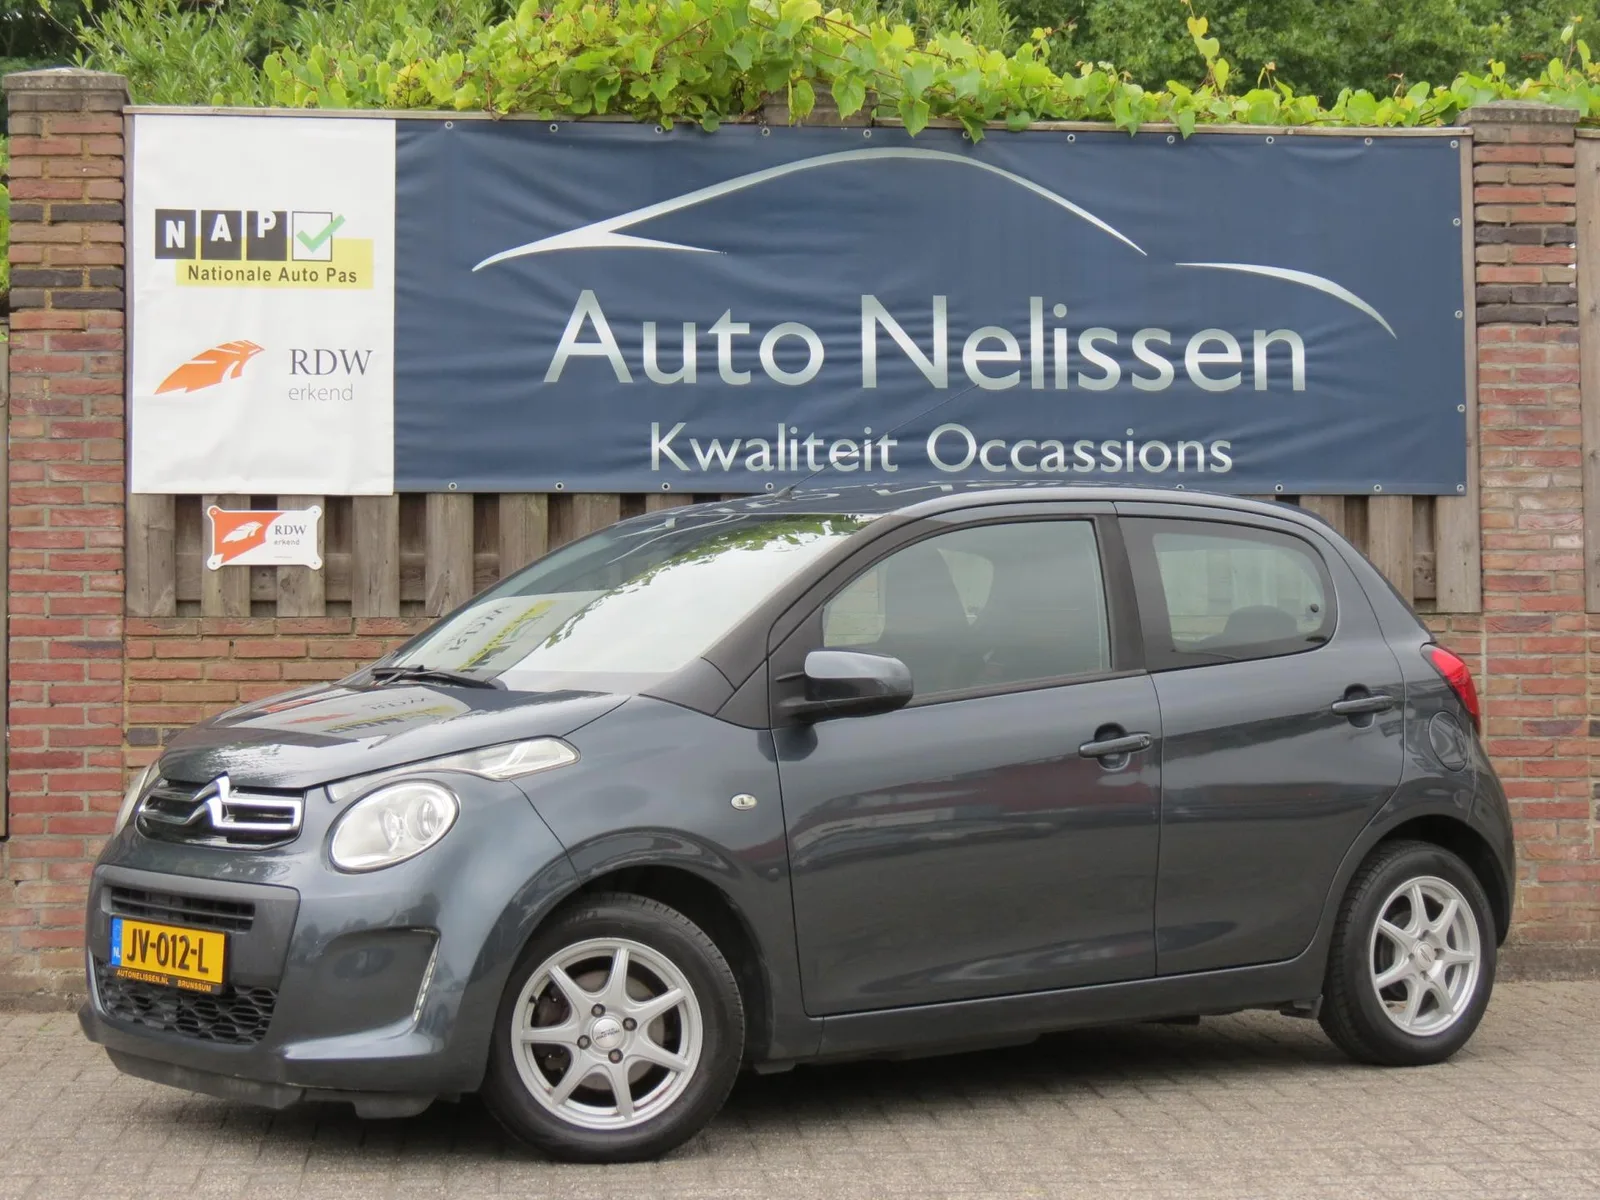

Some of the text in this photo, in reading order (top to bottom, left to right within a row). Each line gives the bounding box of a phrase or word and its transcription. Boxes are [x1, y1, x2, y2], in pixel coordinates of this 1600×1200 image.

[166, 210, 276, 248] NAP
[188, 265, 357, 283] Nationale Auto Pas
[544, 290, 1306, 392] Auto Nelissen
[290, 349, 372, 375] RDW
[289, 384, 353, 401] erkend
[651, 422, 1233, 473] Kwaliteit Occassions
[274, 524, 307, 536] RDW
[113, 946, 121, 958] NL
[127, 928, 209, 974] JV-012-L
[117, 969, 212, 992] AUTONELISSEN.NL BRUNSSUM
